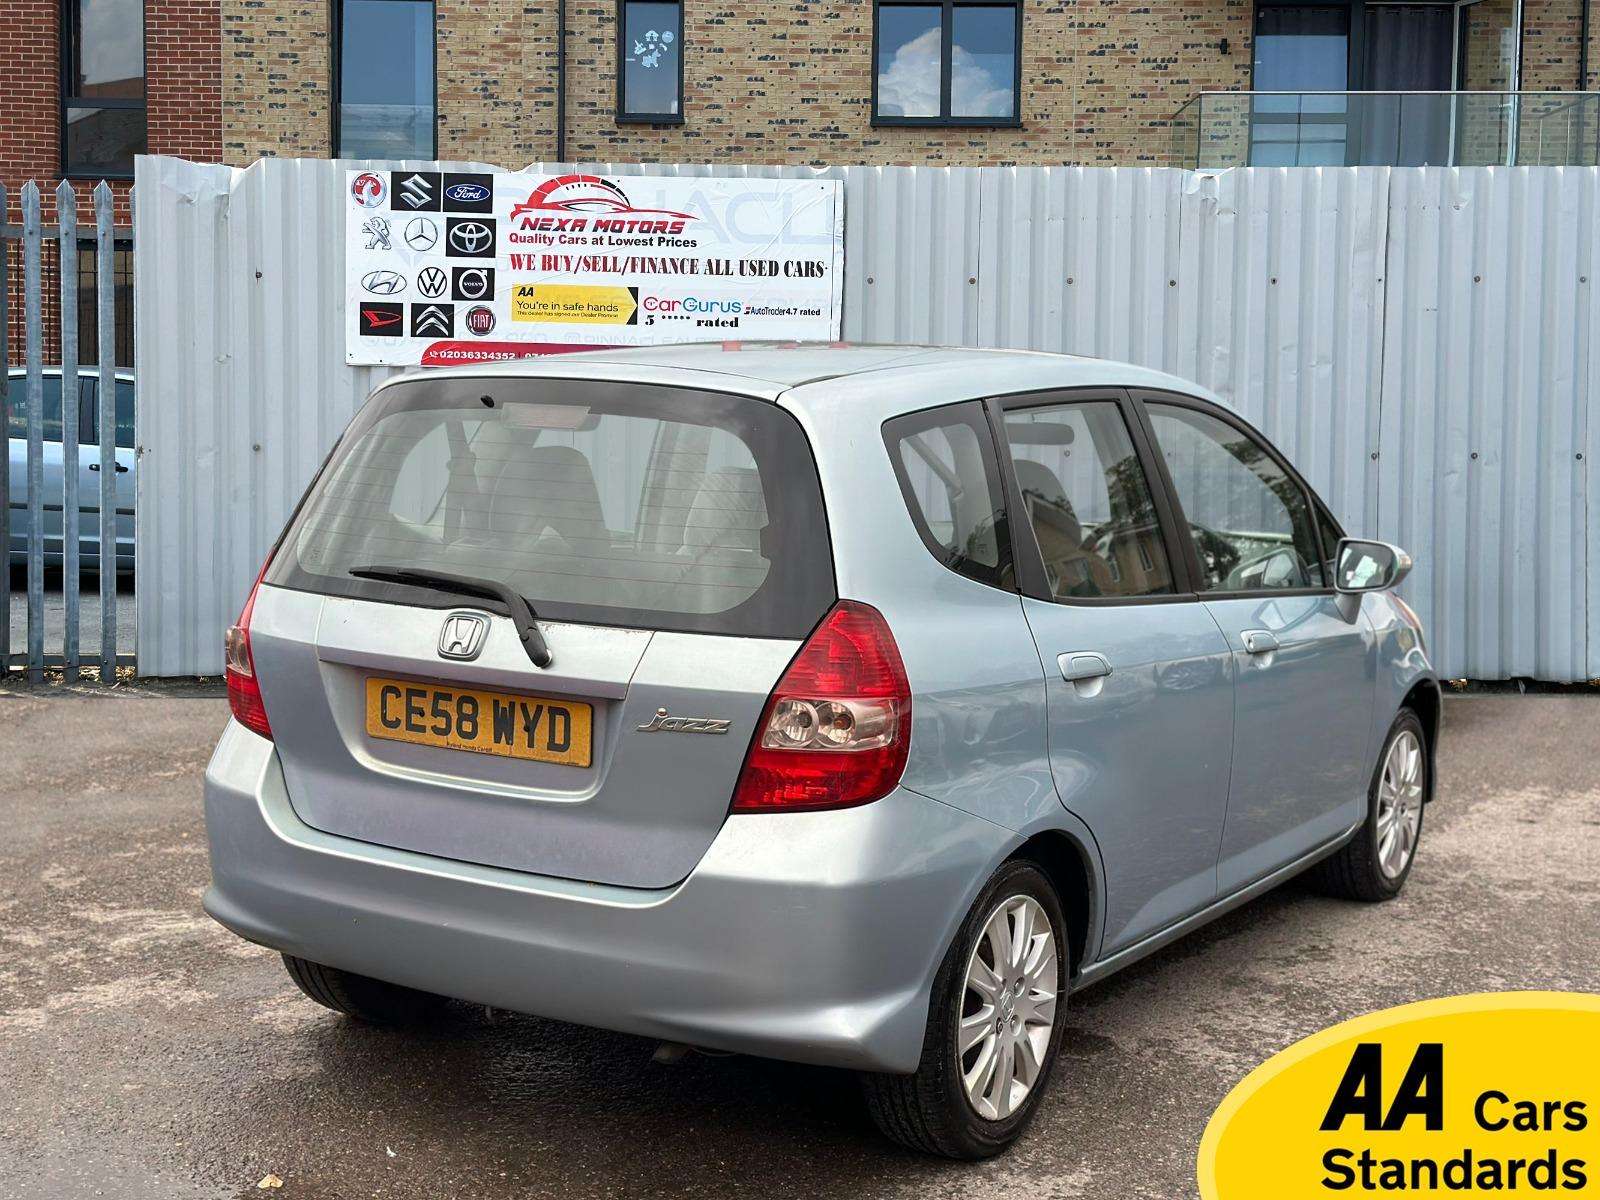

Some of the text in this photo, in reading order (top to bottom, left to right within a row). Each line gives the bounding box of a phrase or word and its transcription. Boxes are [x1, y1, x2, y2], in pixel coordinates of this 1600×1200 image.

[454, 187, 481, 200] Ford
[520, 217, 686, 235] NEXA MOTORS
[509, 232, 697, 248] Quality Cars at Lowest Prices
[510, 253, 824, 278] WE BUY/SELL/FINANCE ALL USED CARS
[518, 287, 534, 297] AA
[516, 301, 619, 312] You're in safe hands
[643, 296, 742, 313] CarGurus
[799, 308, 821, 316] rated
[472, 315, 492, 328] FIAT
[645, 314, 739, 328] 5 rated
[380, 685, 572, 753] CE58 WYD
